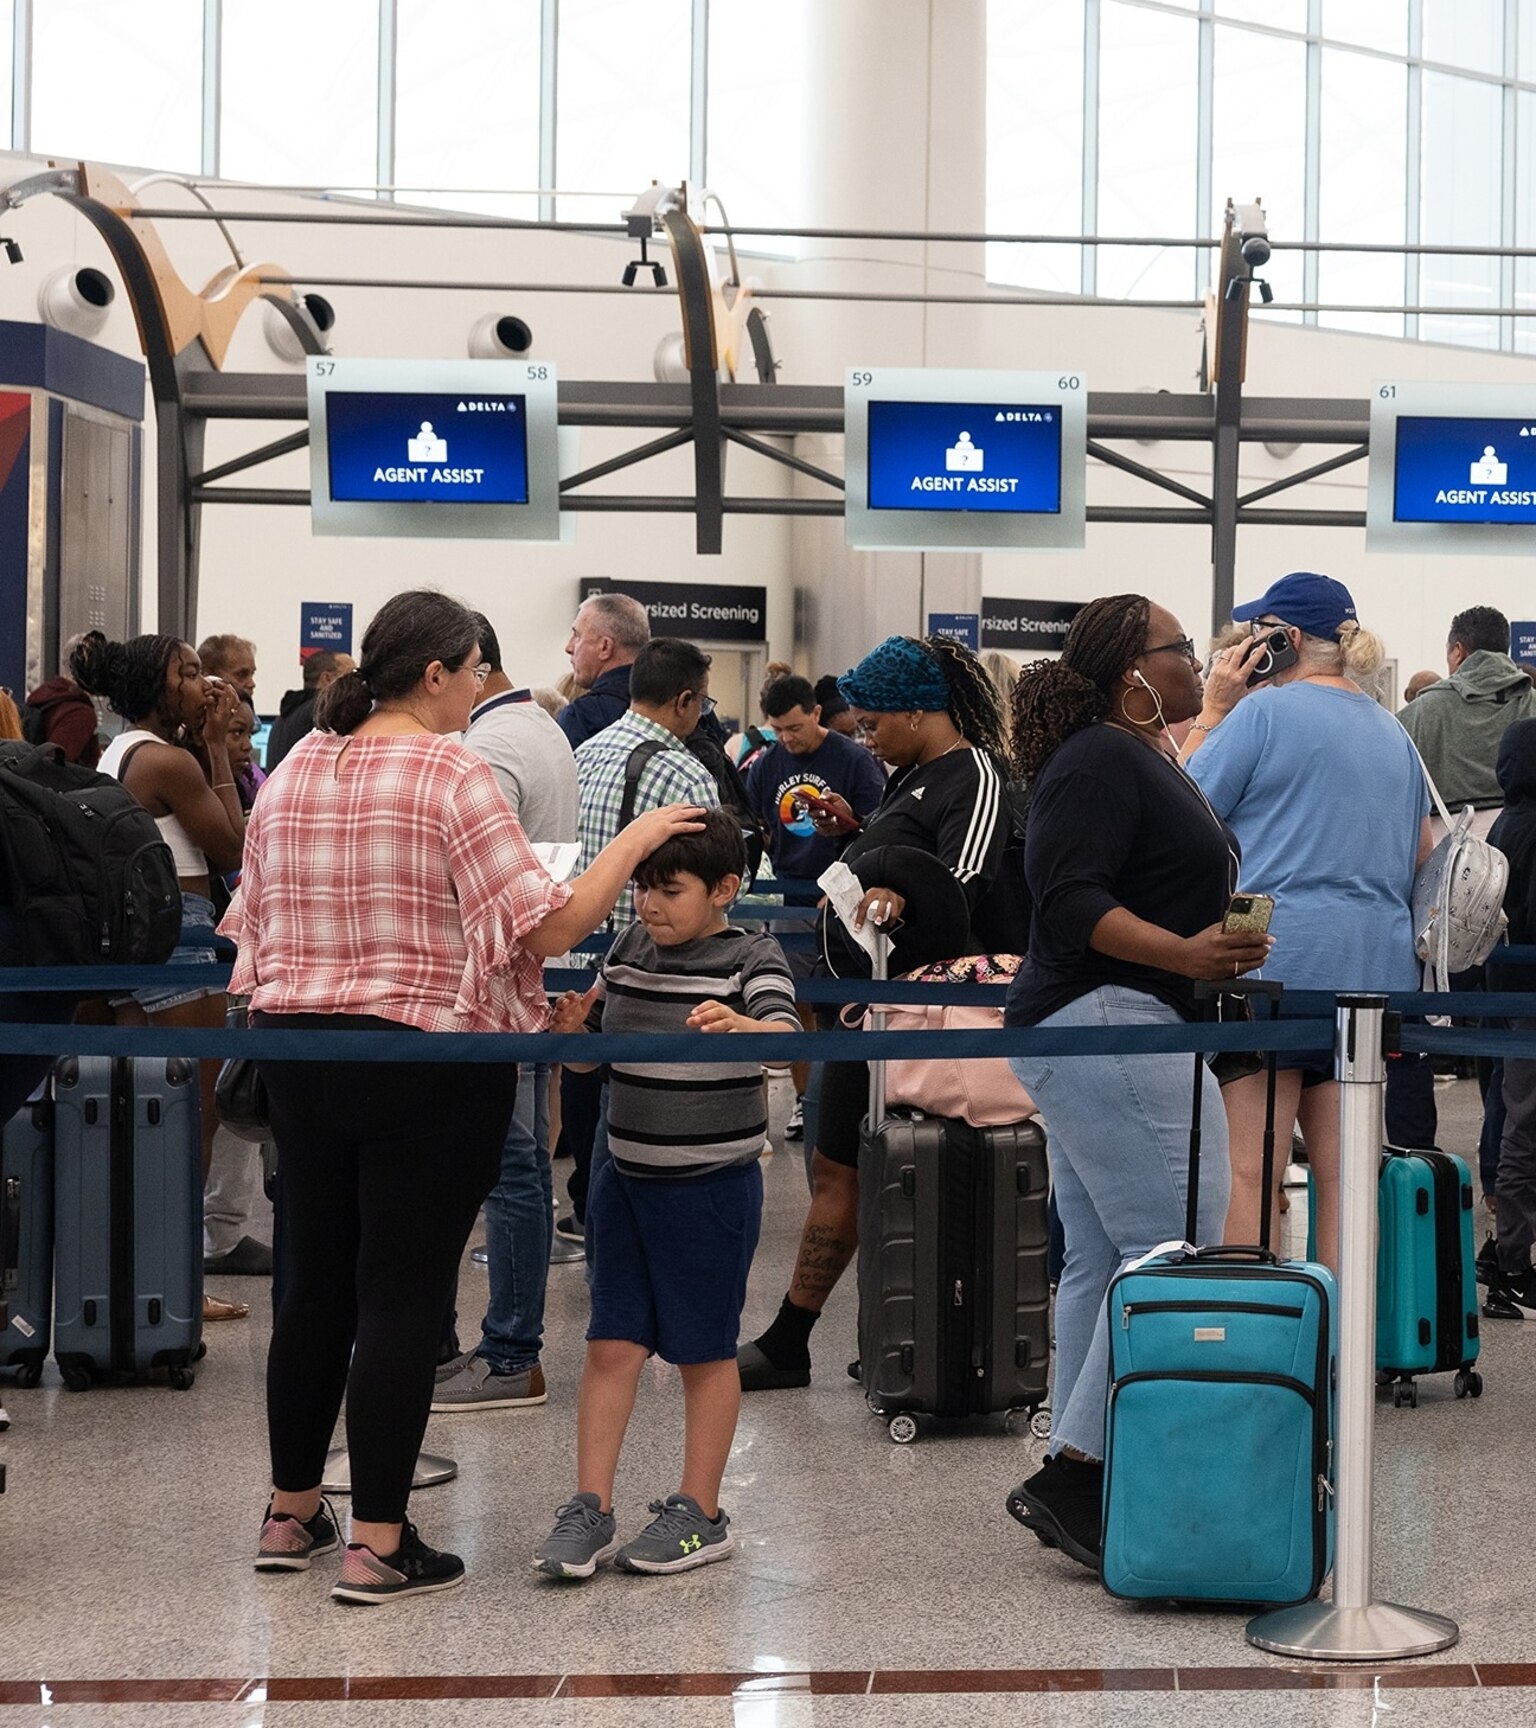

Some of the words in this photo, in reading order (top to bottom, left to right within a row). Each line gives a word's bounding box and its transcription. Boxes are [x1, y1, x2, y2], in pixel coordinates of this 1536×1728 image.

[316, 362, 336, 376] 57
[527, 366, 548, 381] 58
[852, 372, 873, 386] 59
[1058, 376, 1080, 390] 60
[1379, 385, 1397, 399] 61
[468, 401, 506, 412] DELTA
[1006, 412, 1042, 422] DELTA
[373, 467, 428, 483] AGENT
[431, 468, 484, 484] ASSIST
[911, 476, 964, 491] AGENT
[967, 477, 1019, 493] ASSIST
[1435, 490, 1488, 505] AGENT
[645, 602, 687, 618] rsized
[691, 603, 759, 624] Screening
[311, 617, 327, 625] STAY
[328, 617, 343, 625] SAFE
[981, 616, 1018, 631] rsized
[1020, 617, 1071, 633] Screenin
[775, 774, 802, 805] HURLEY
[803, 773, 827, 787] SURF
